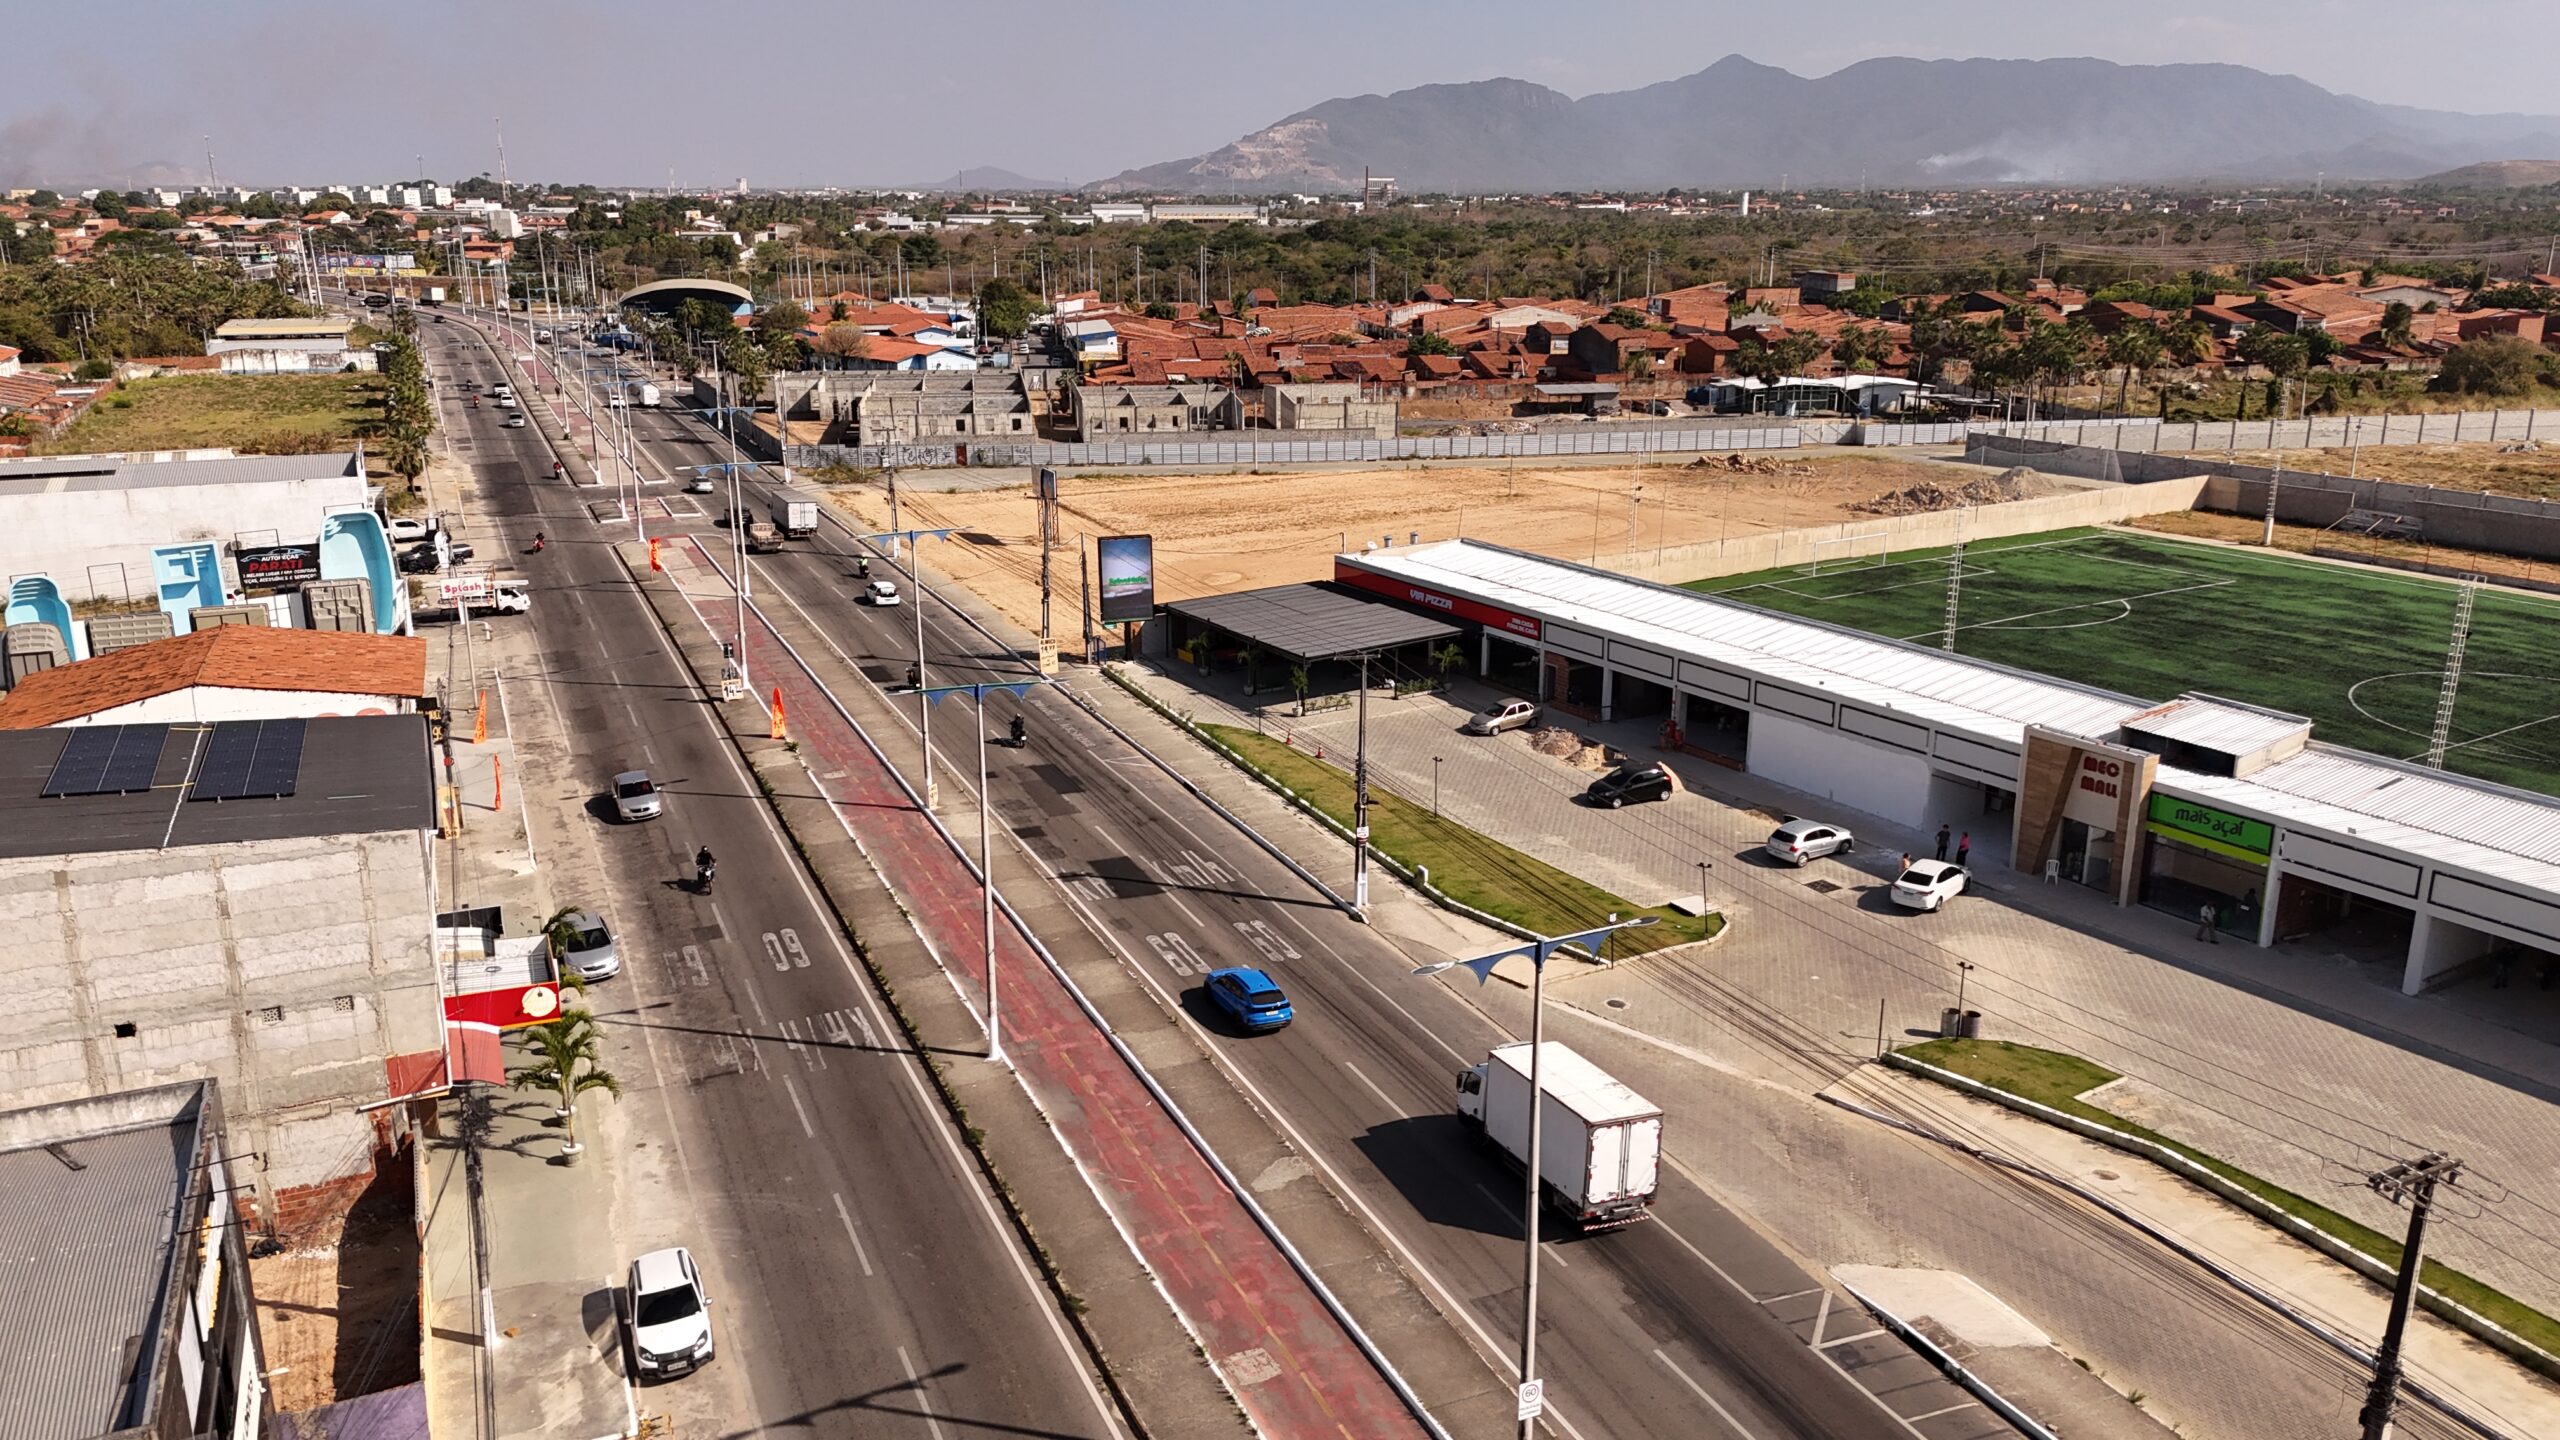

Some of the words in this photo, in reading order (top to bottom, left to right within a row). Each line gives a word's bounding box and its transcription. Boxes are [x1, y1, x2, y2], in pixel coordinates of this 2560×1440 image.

[249, 560, 303, 571] PARATI
[444, 582, 482, 594] Splash
[1409, 589, 1425, 603] VIA
[1425, 594, 1452, 609] PIZZA
[2083, 756, 2120, 778] MEC
[2080, 775, 2118, 798] MALL
[2175, 807, 2212, 825] mais
[2212, 820, 2246, 837] açaí
[762, 928, 811, 972] 60
[1233, 919, 1302, 962] 60
[1145, 932, 1213, 977] 60
[1525, 1387, 1536, 1398] 60
